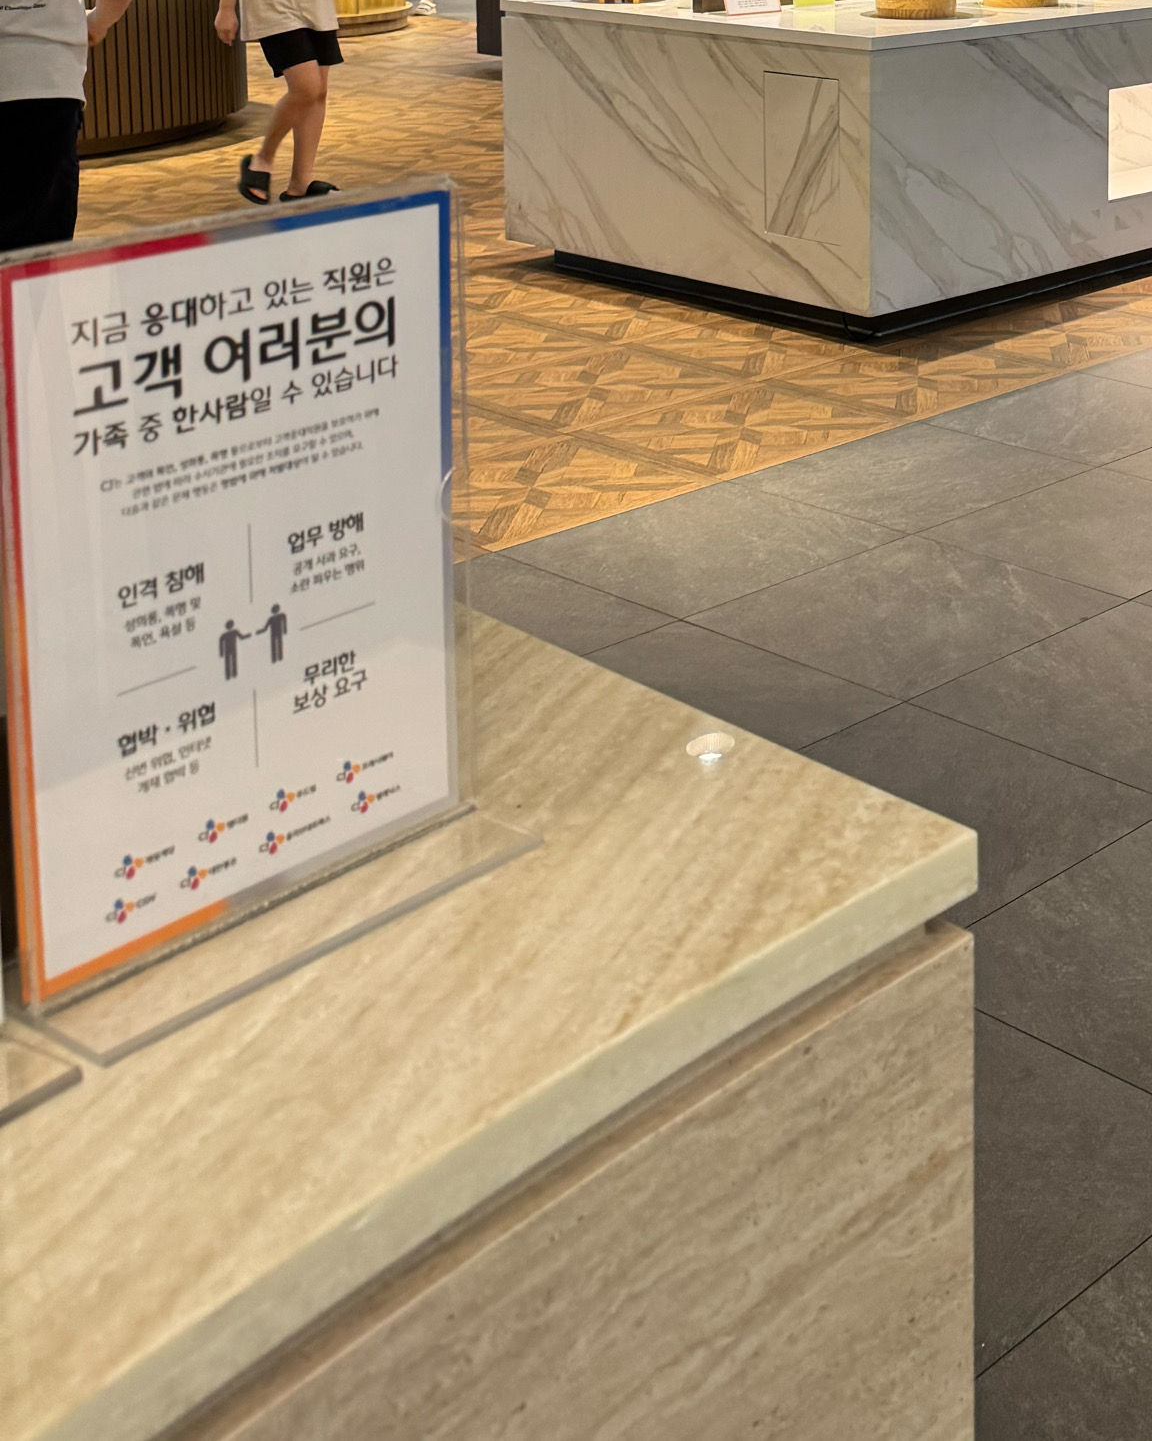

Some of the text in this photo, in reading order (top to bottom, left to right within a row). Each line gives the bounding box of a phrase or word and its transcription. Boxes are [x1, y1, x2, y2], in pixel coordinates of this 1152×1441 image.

[72, 257, 396, 349] 지금 응대하고 있는 직원은
[74, 296, 396, 416] 고객 여러분의
[74, 354, 398, 456] 가족 중 한사람일 수 있습니다
[288, 512, 364, 554] 업무 방해
[118, 562, 204, 609] 인격 침해
[293, 669, 367, 714] 보상 요구
[304, 650, 356, 685] 무리한
[118, 701, 215, 758] 협박 위협
